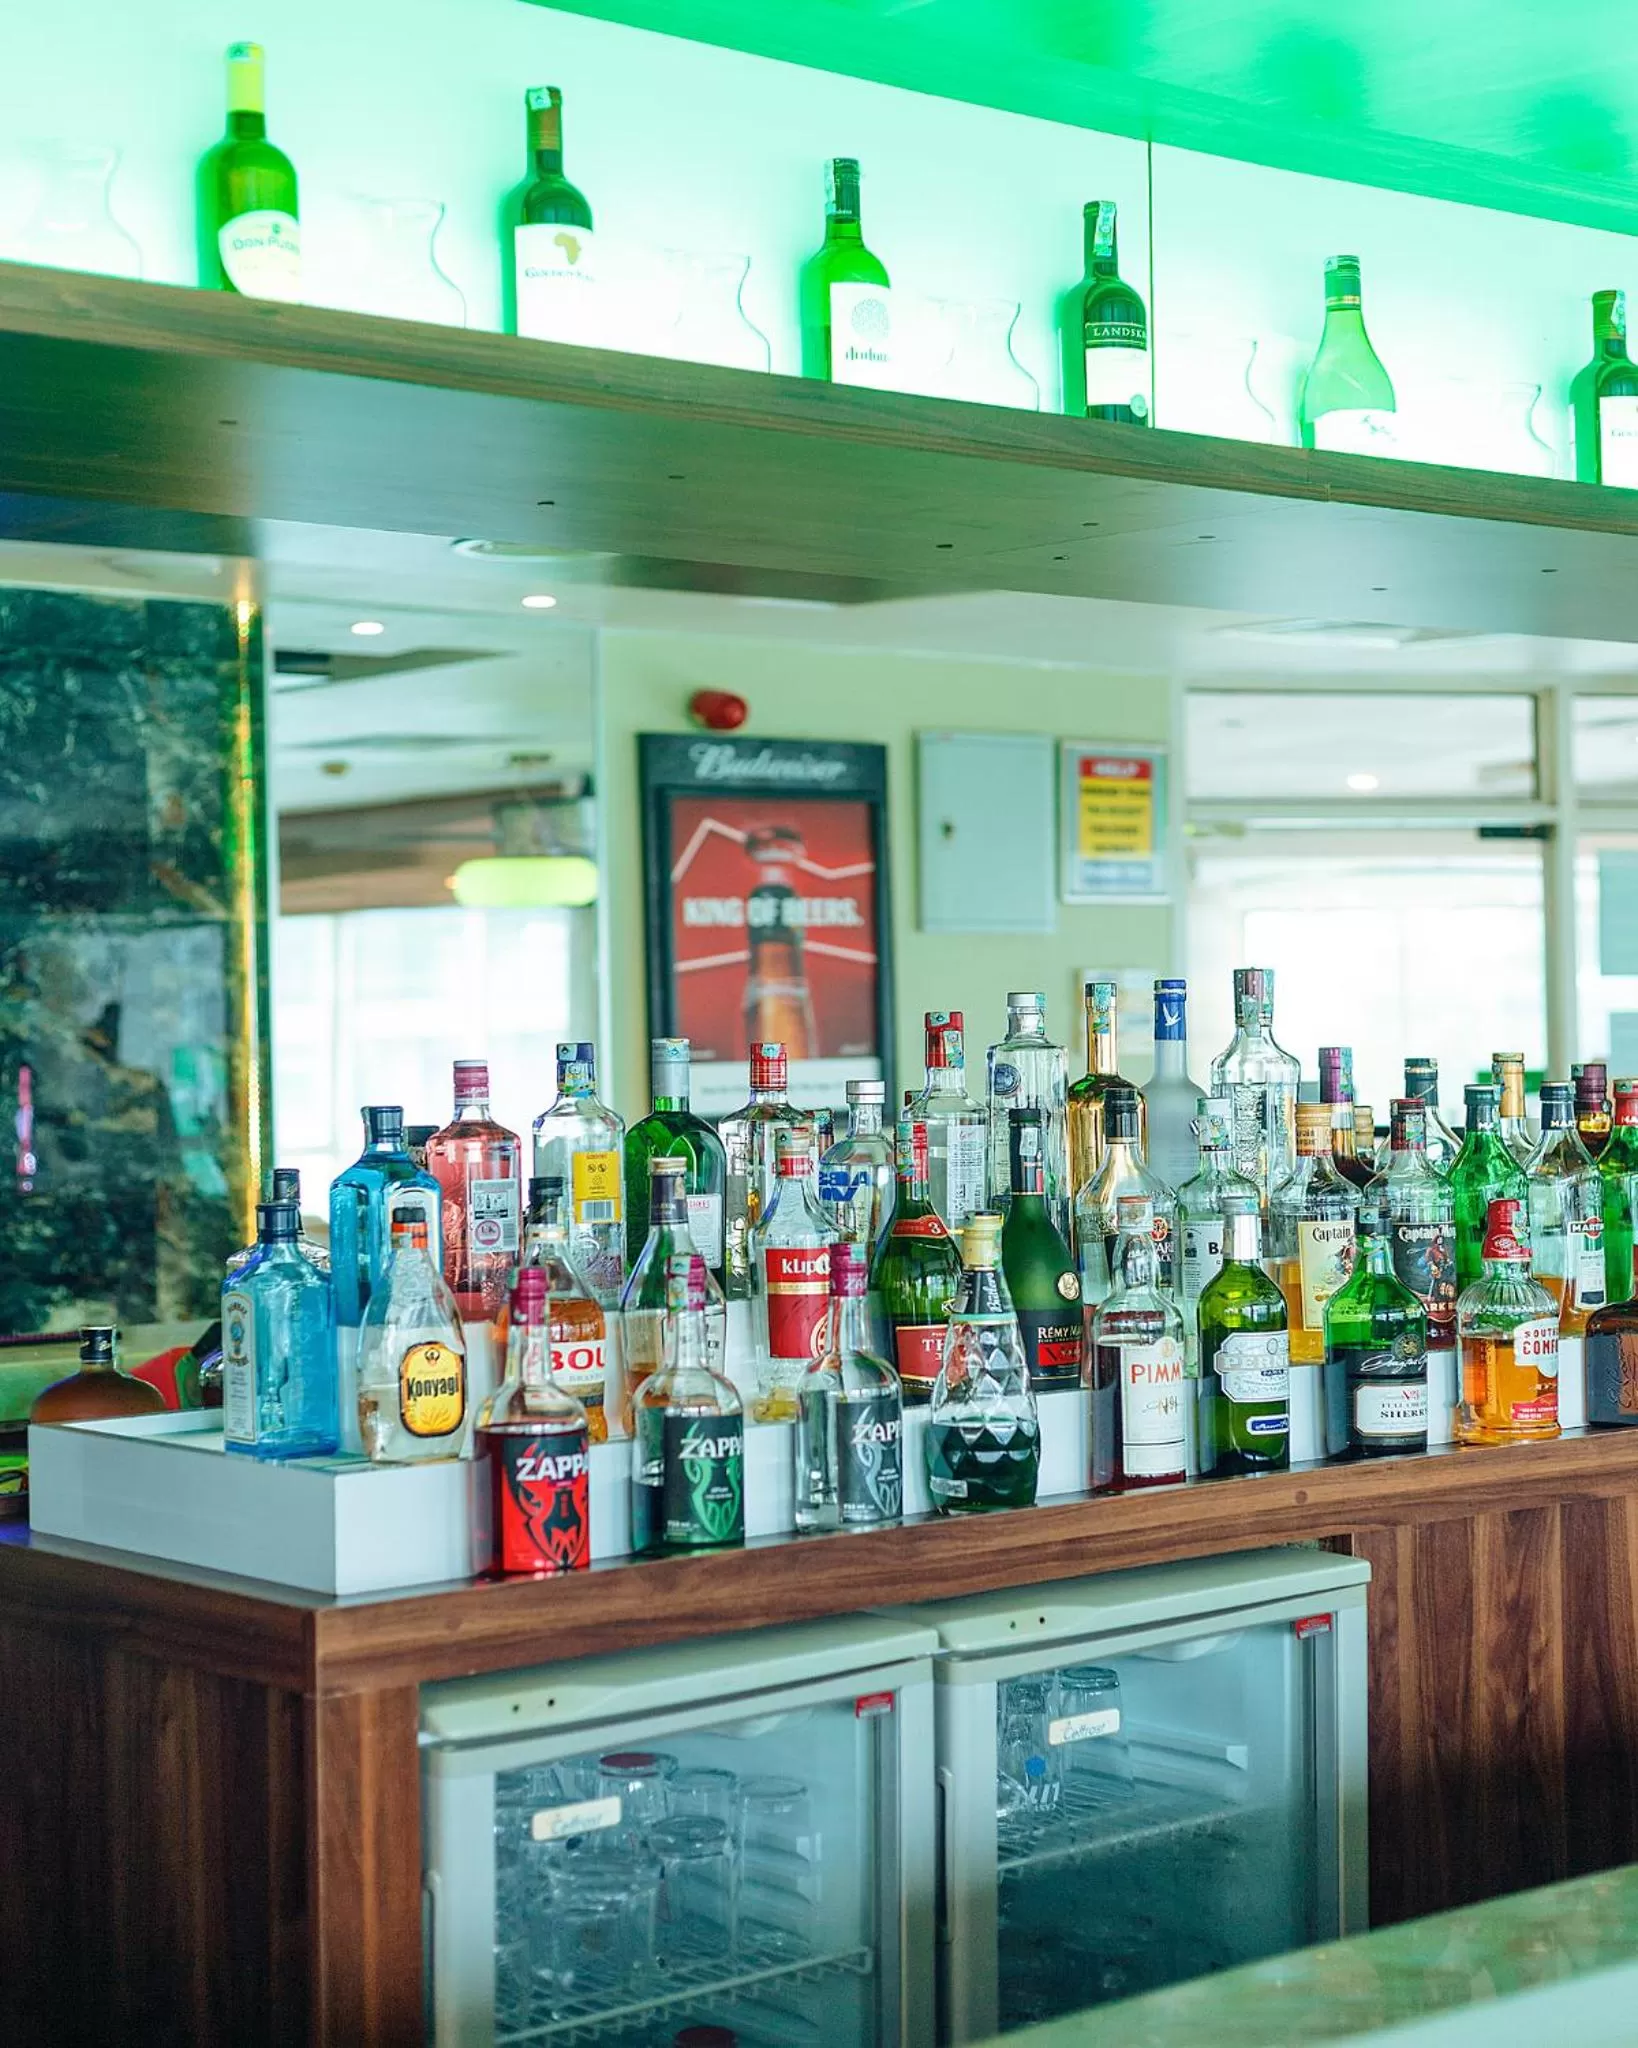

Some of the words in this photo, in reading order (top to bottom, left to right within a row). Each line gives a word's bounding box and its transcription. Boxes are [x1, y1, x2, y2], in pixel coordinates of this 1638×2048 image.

[688, 743, 847, 782] Budweiser
[684, 897, 744, 927] KING
[748, 897, 778, 927] OF
[928, 1222, 942, 1235] 3
[1313, 1226, 1351, 1242] Captain
[406, 1372, 459, 1401] Konyagi
